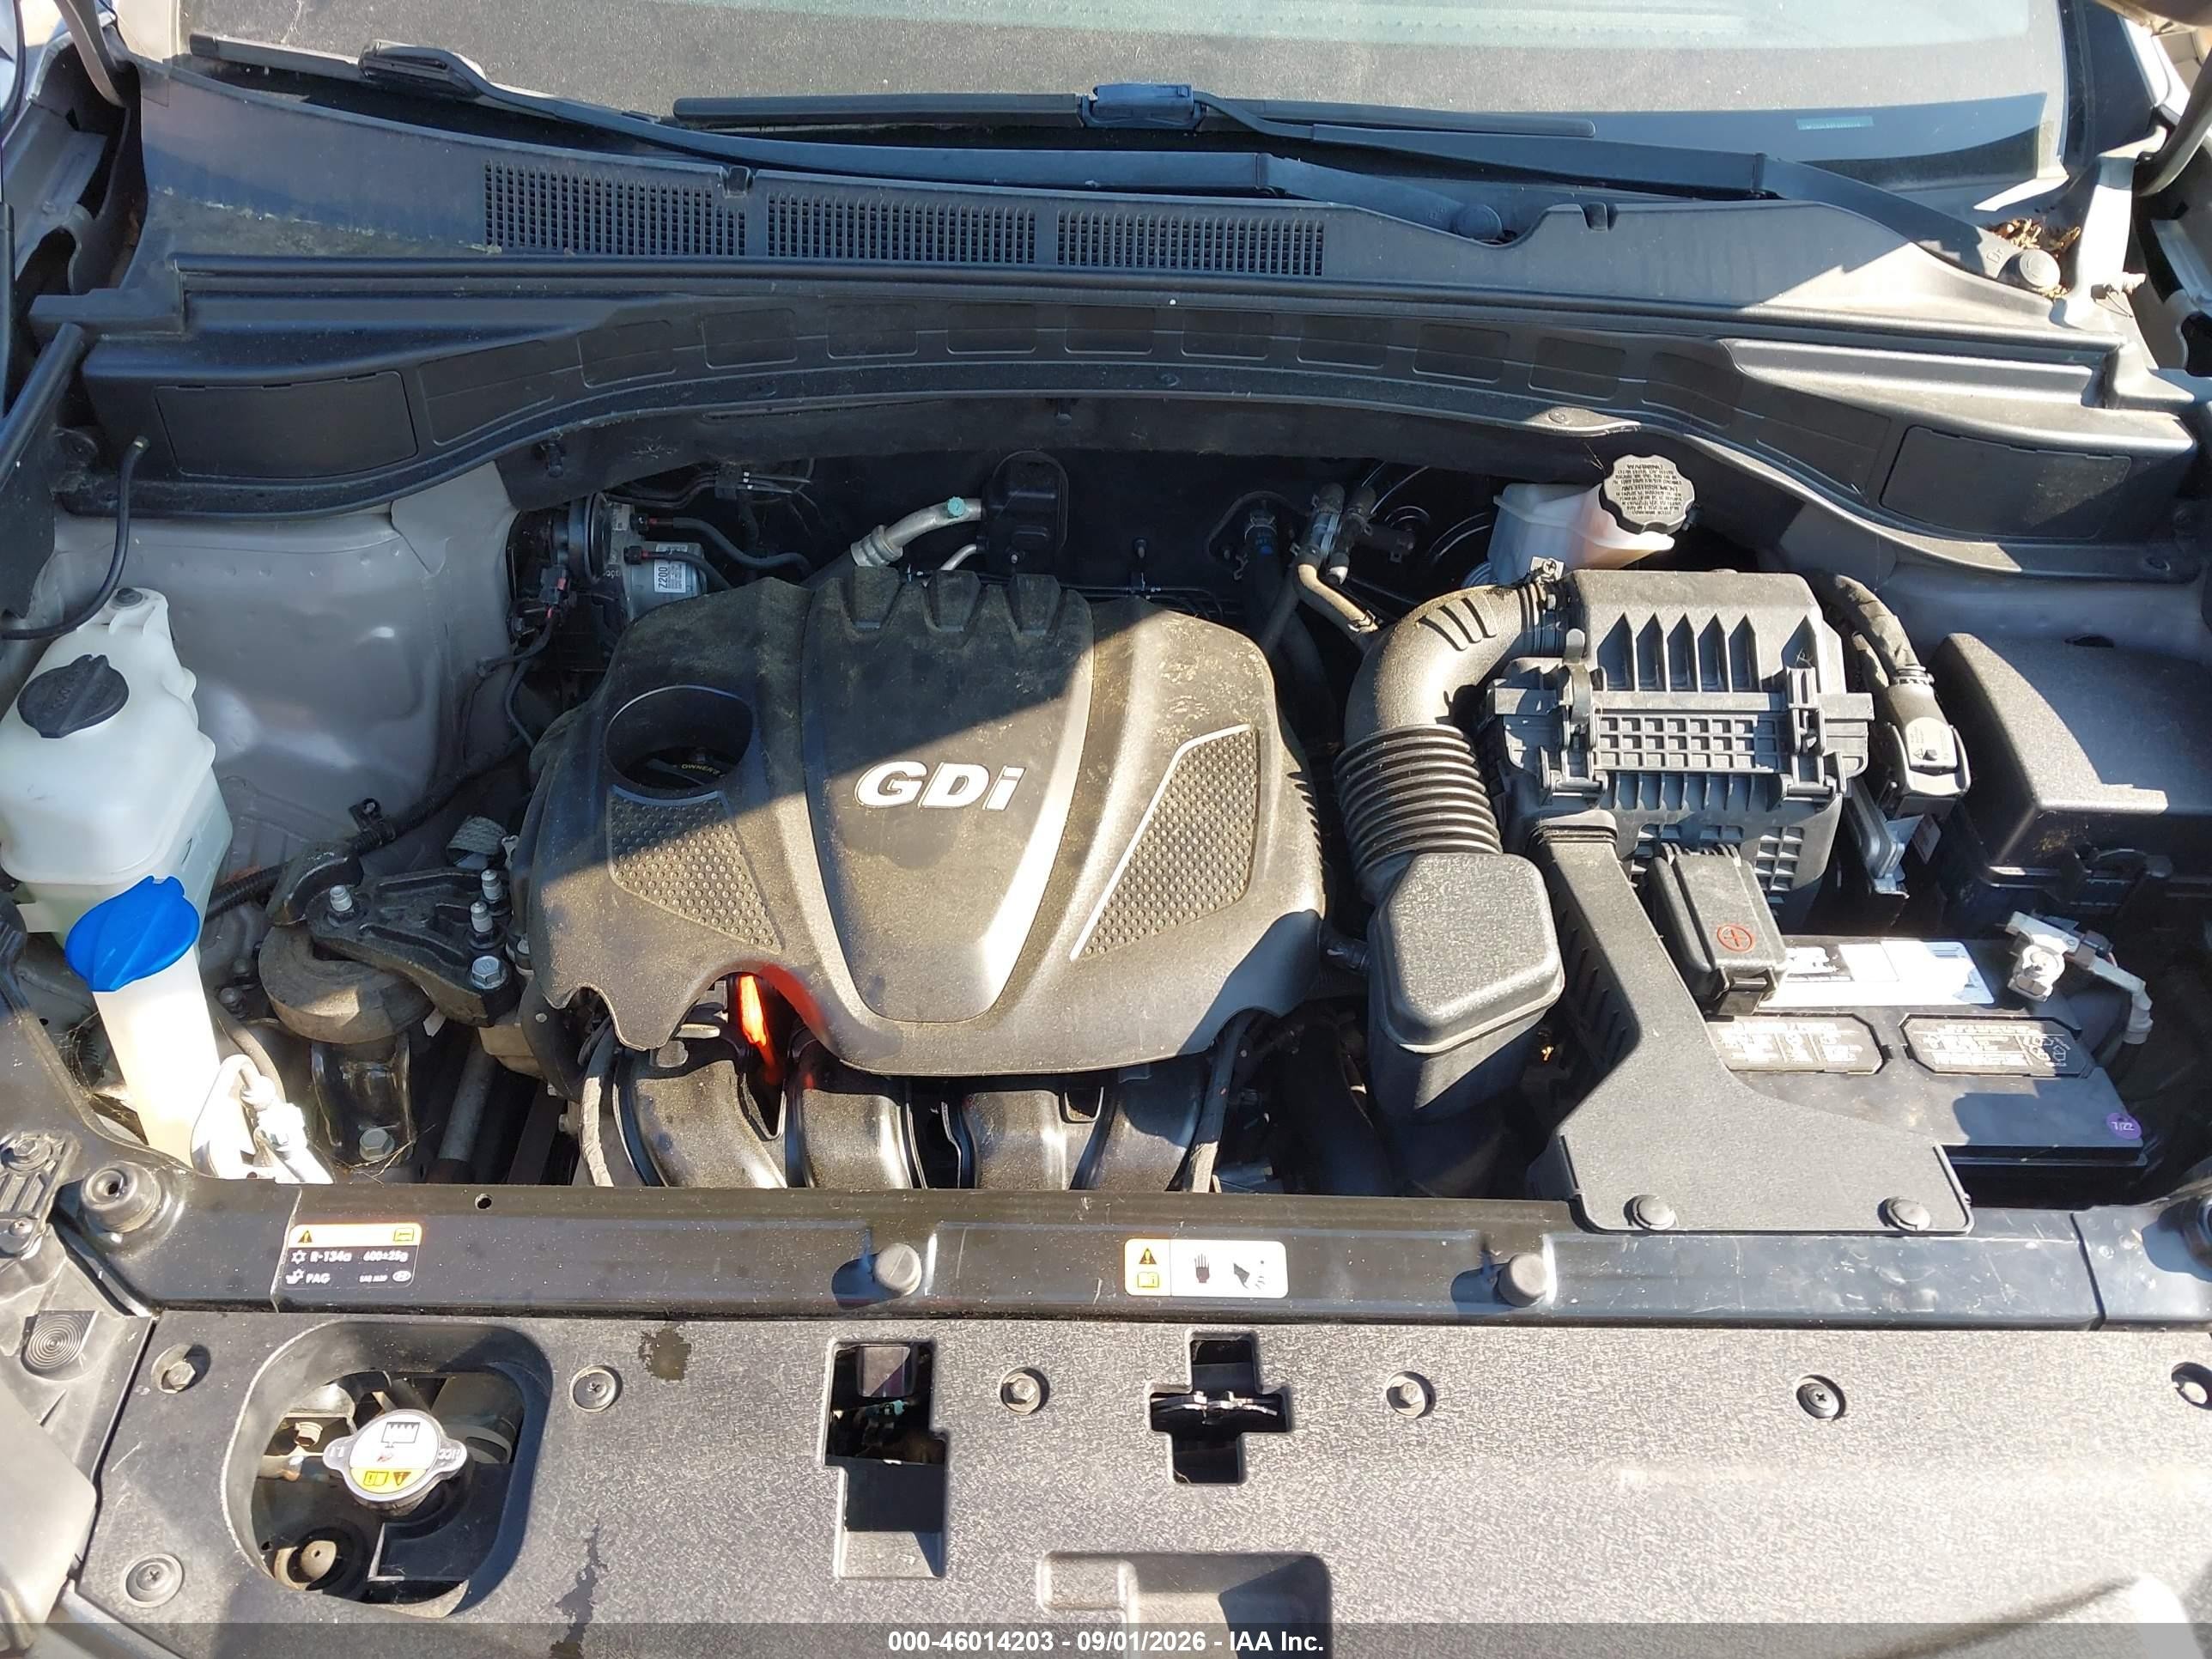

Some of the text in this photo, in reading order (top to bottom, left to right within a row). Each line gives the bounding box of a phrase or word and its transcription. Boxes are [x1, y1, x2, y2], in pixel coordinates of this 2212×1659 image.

[658, 567, 668, 589] Z200
[854, 761, 1026, 811] GDi
[306, 1273, 331, 1284] PAG
